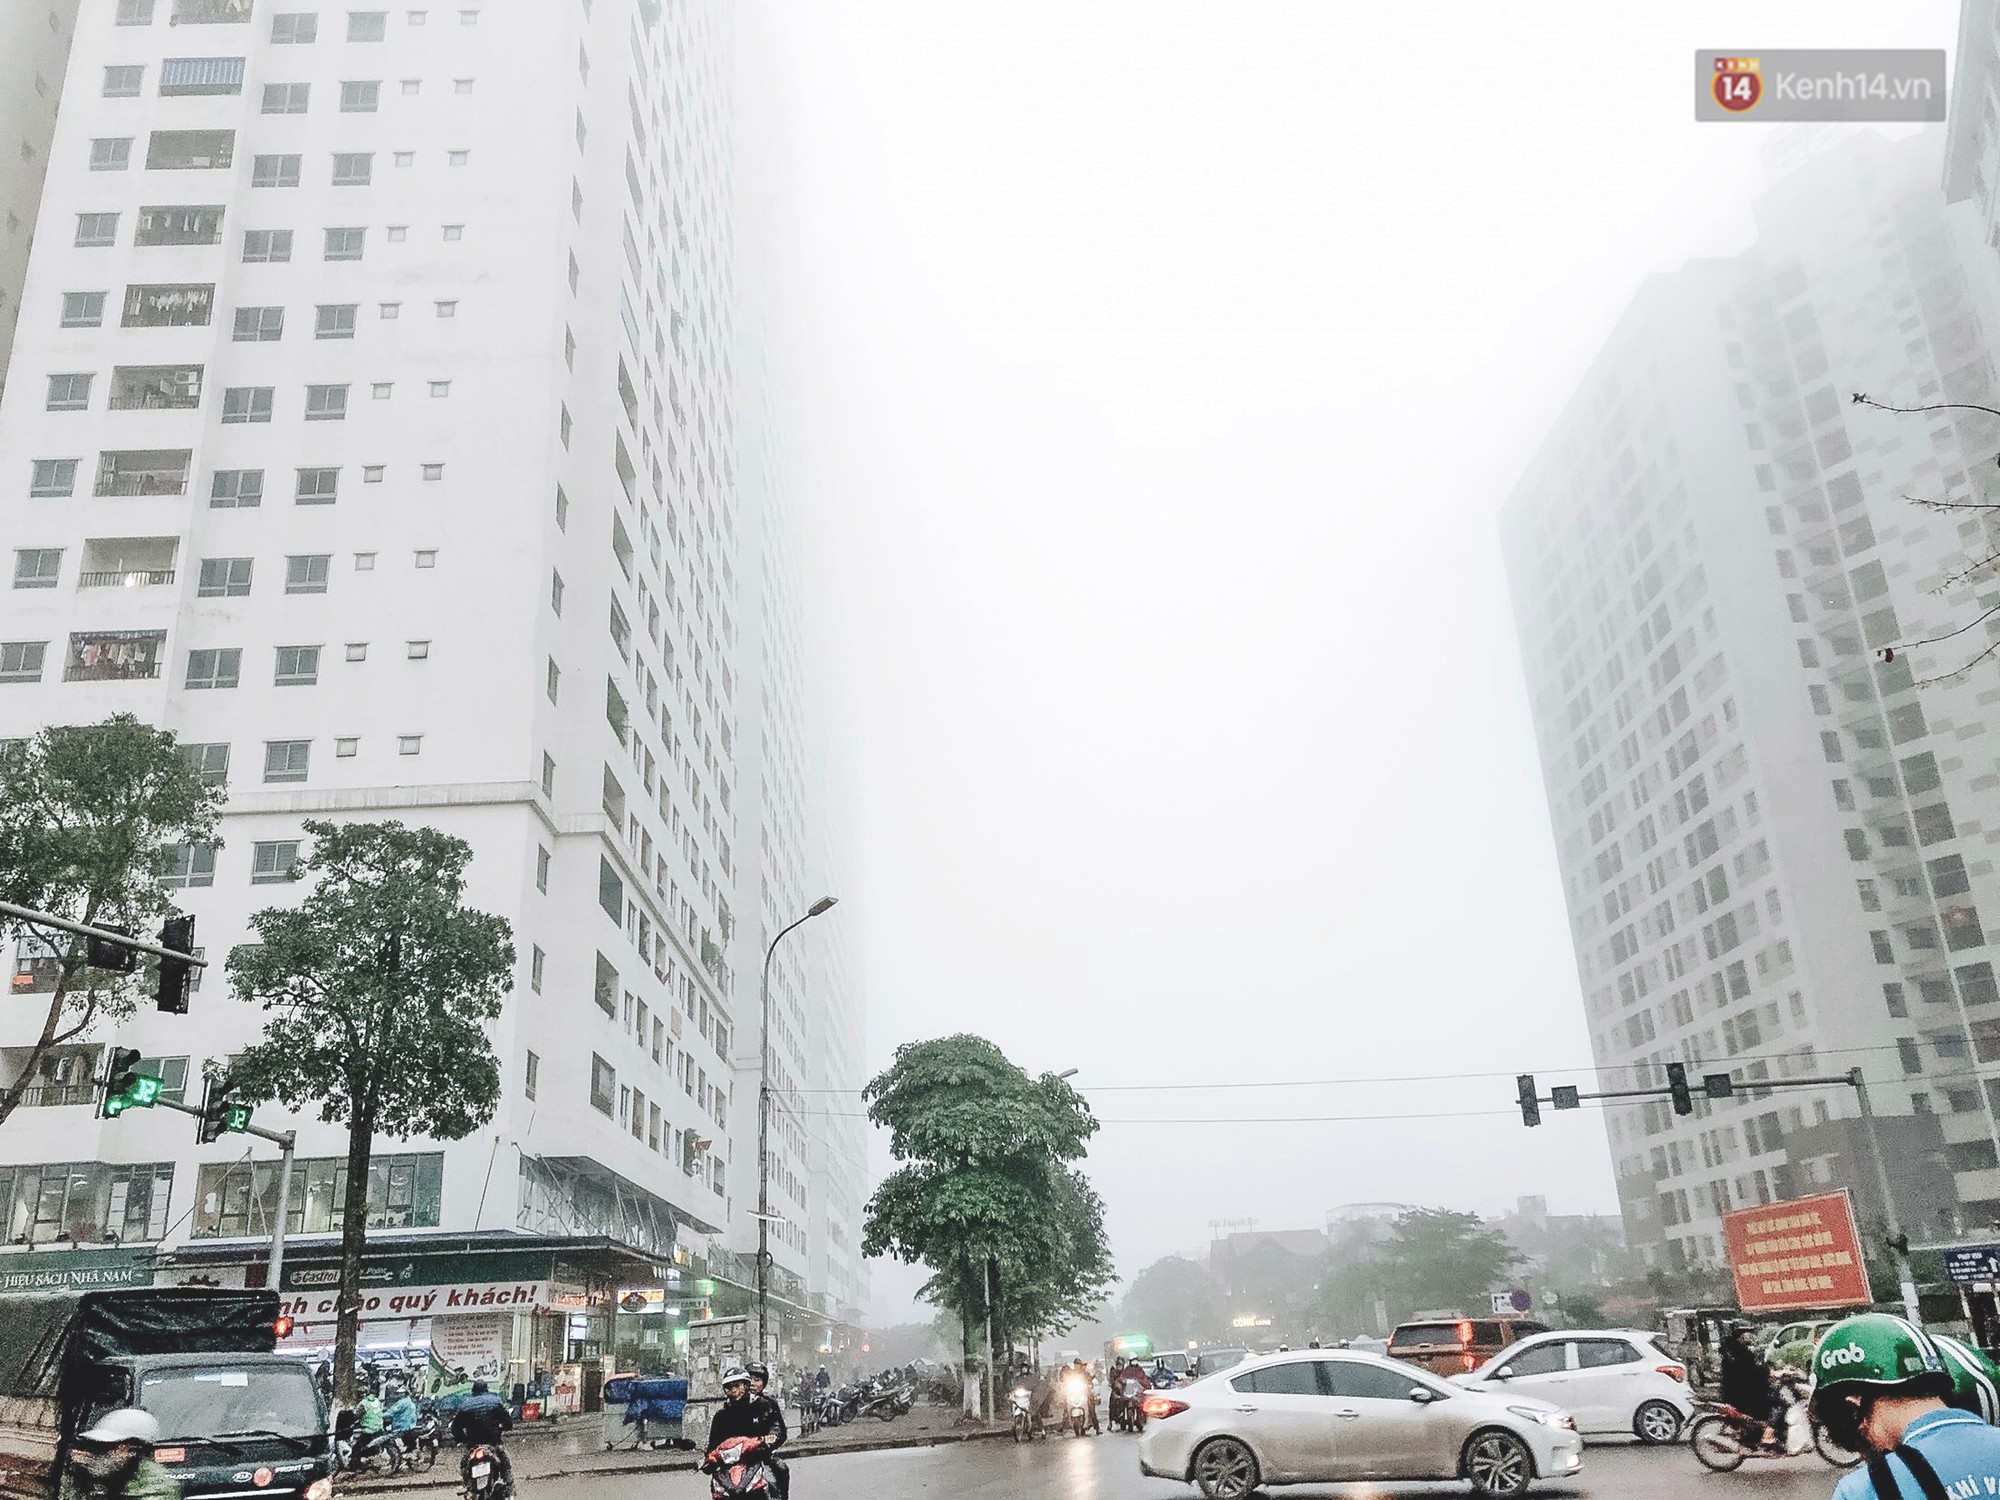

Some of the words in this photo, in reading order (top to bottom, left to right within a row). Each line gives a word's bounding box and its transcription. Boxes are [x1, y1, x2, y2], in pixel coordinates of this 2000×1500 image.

[34, 1271, 67, 1286] SÁCH
[70, 1269, 99, 1284] NHÃ
[102, 1270, 133, 1282] NAM
[302, 1270, 338, 1283] Castrol
[280, 1296, 308, 1315] nh
[389, 1288, 438, 1313] quý
[446, 1284, 538, 1307] khách!
[1821, 1341, 1865, 1369] Grab
